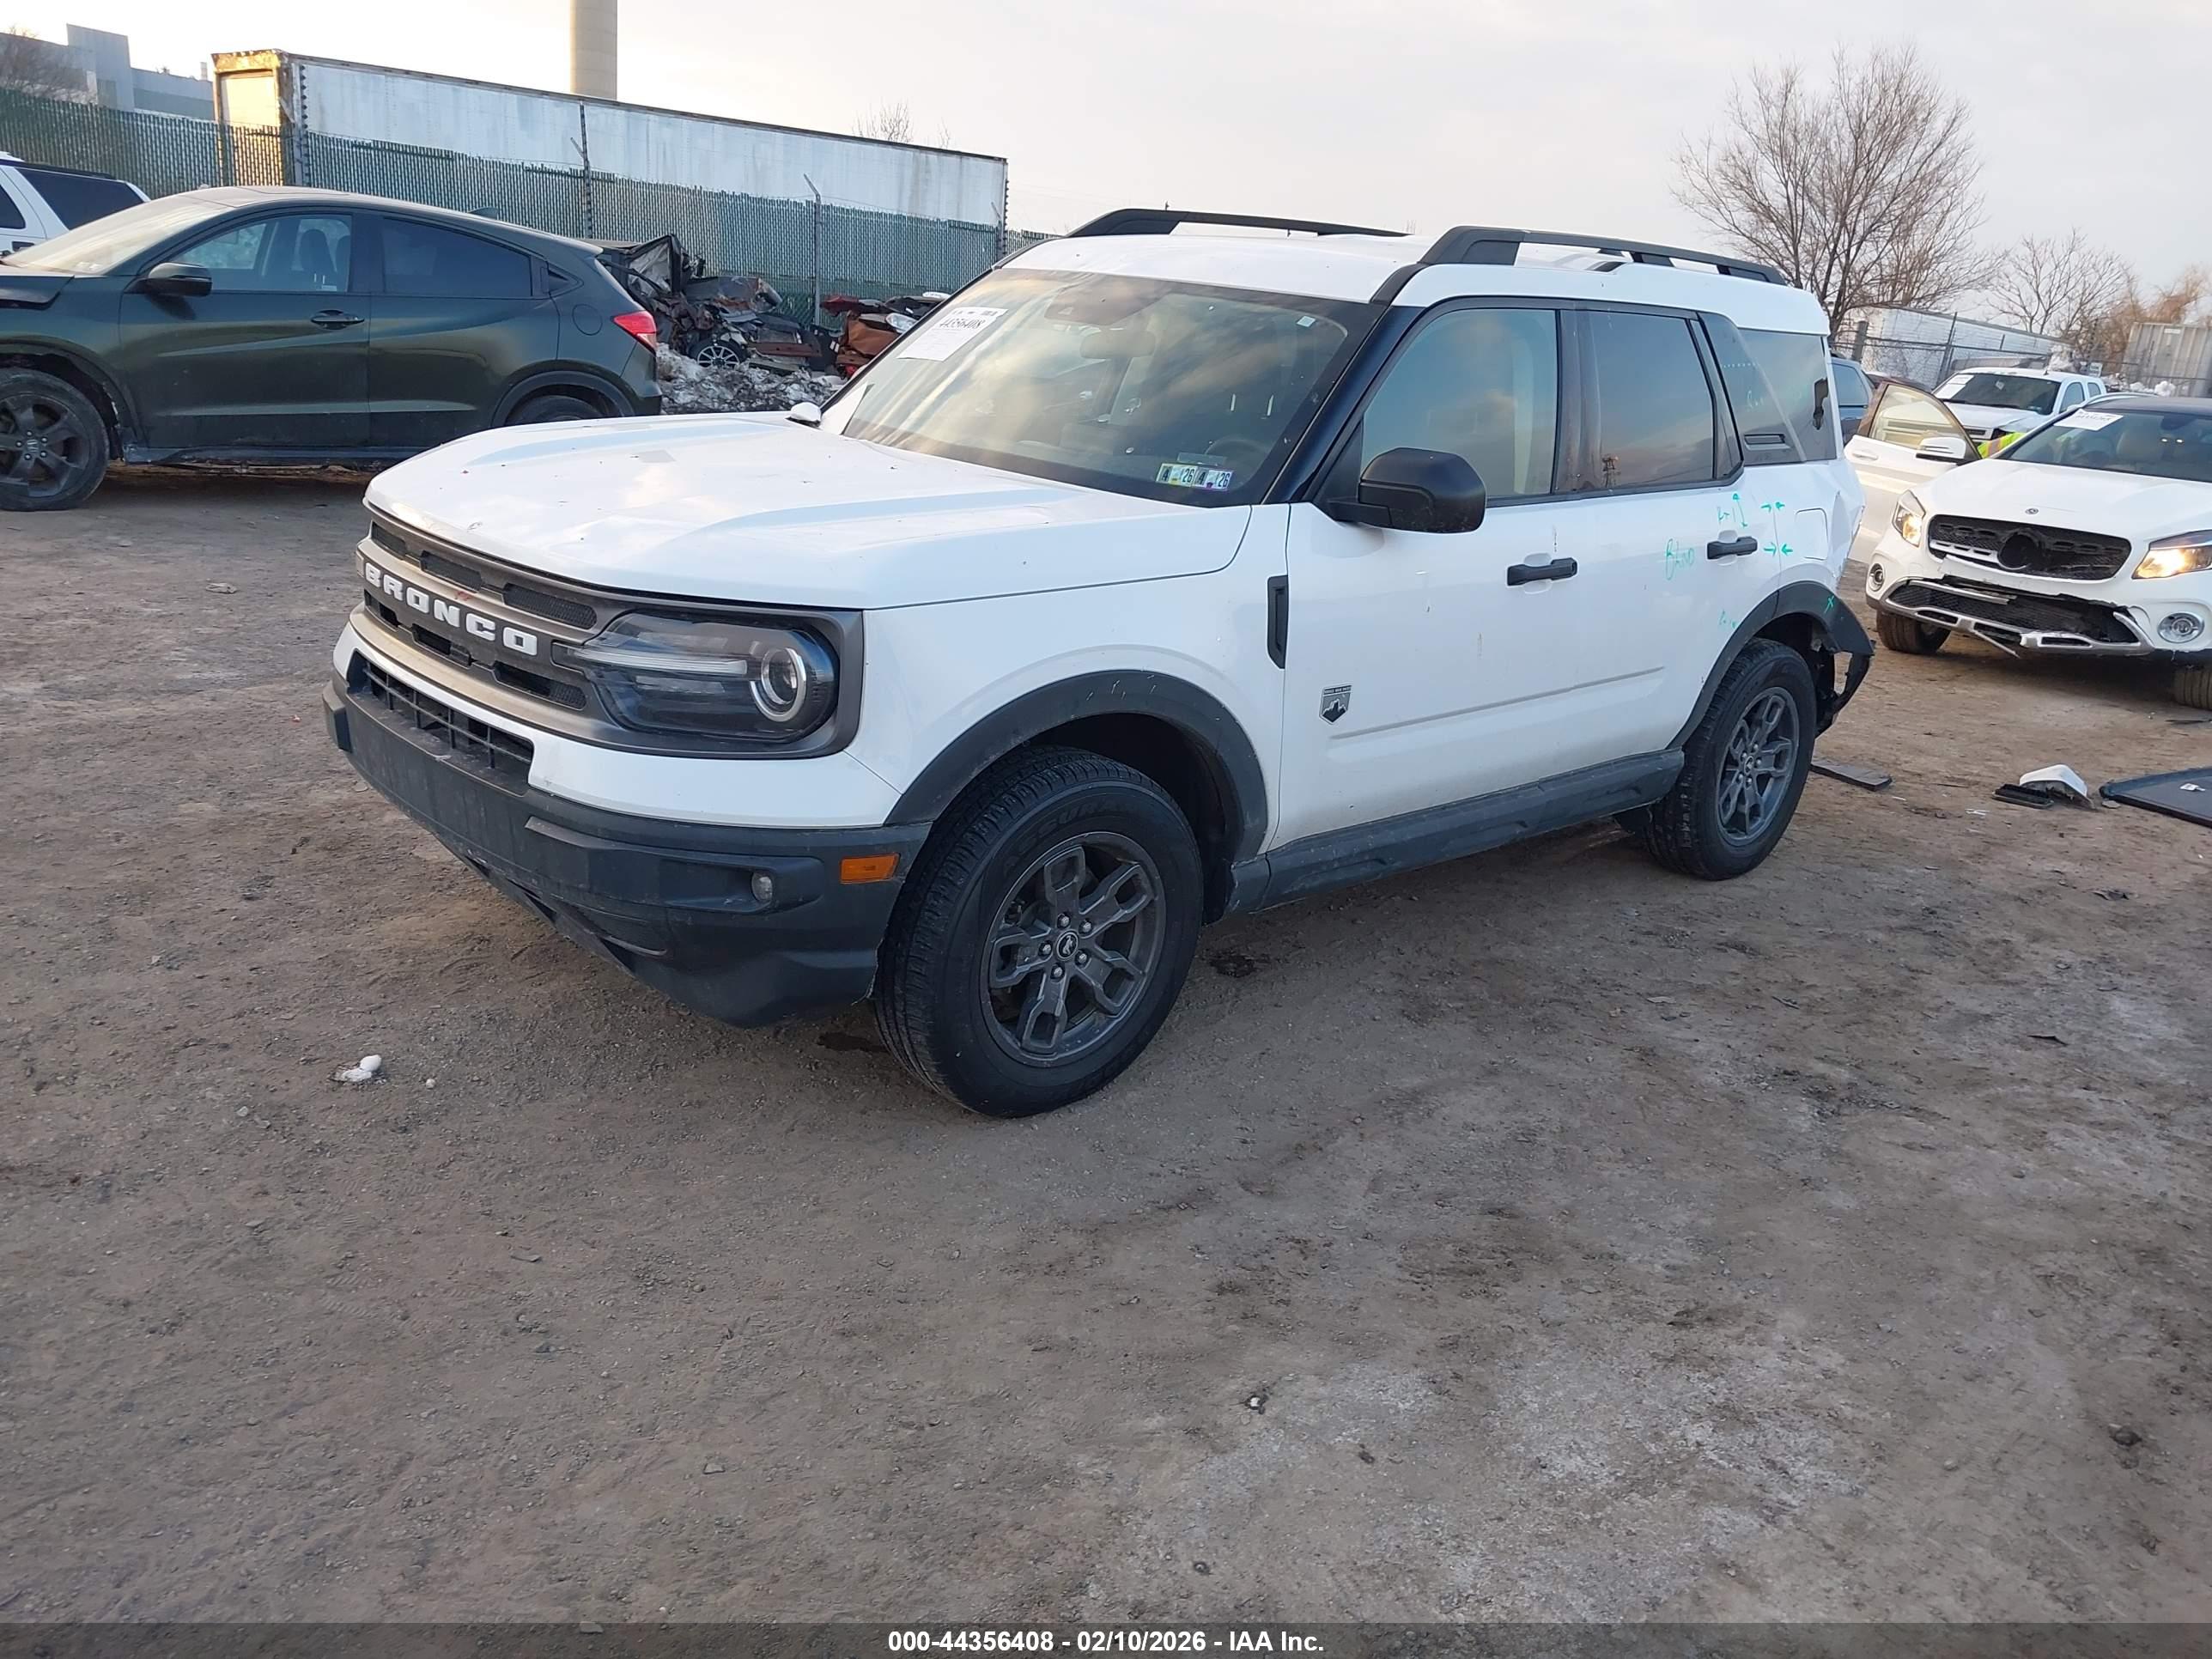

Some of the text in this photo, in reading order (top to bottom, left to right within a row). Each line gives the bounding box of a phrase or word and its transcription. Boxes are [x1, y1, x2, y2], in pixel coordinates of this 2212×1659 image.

[1161, 469, 1170, 481] 4
[1198, 471, 1206, 485] 4
[365, 562, 538, 657] BRONCO
